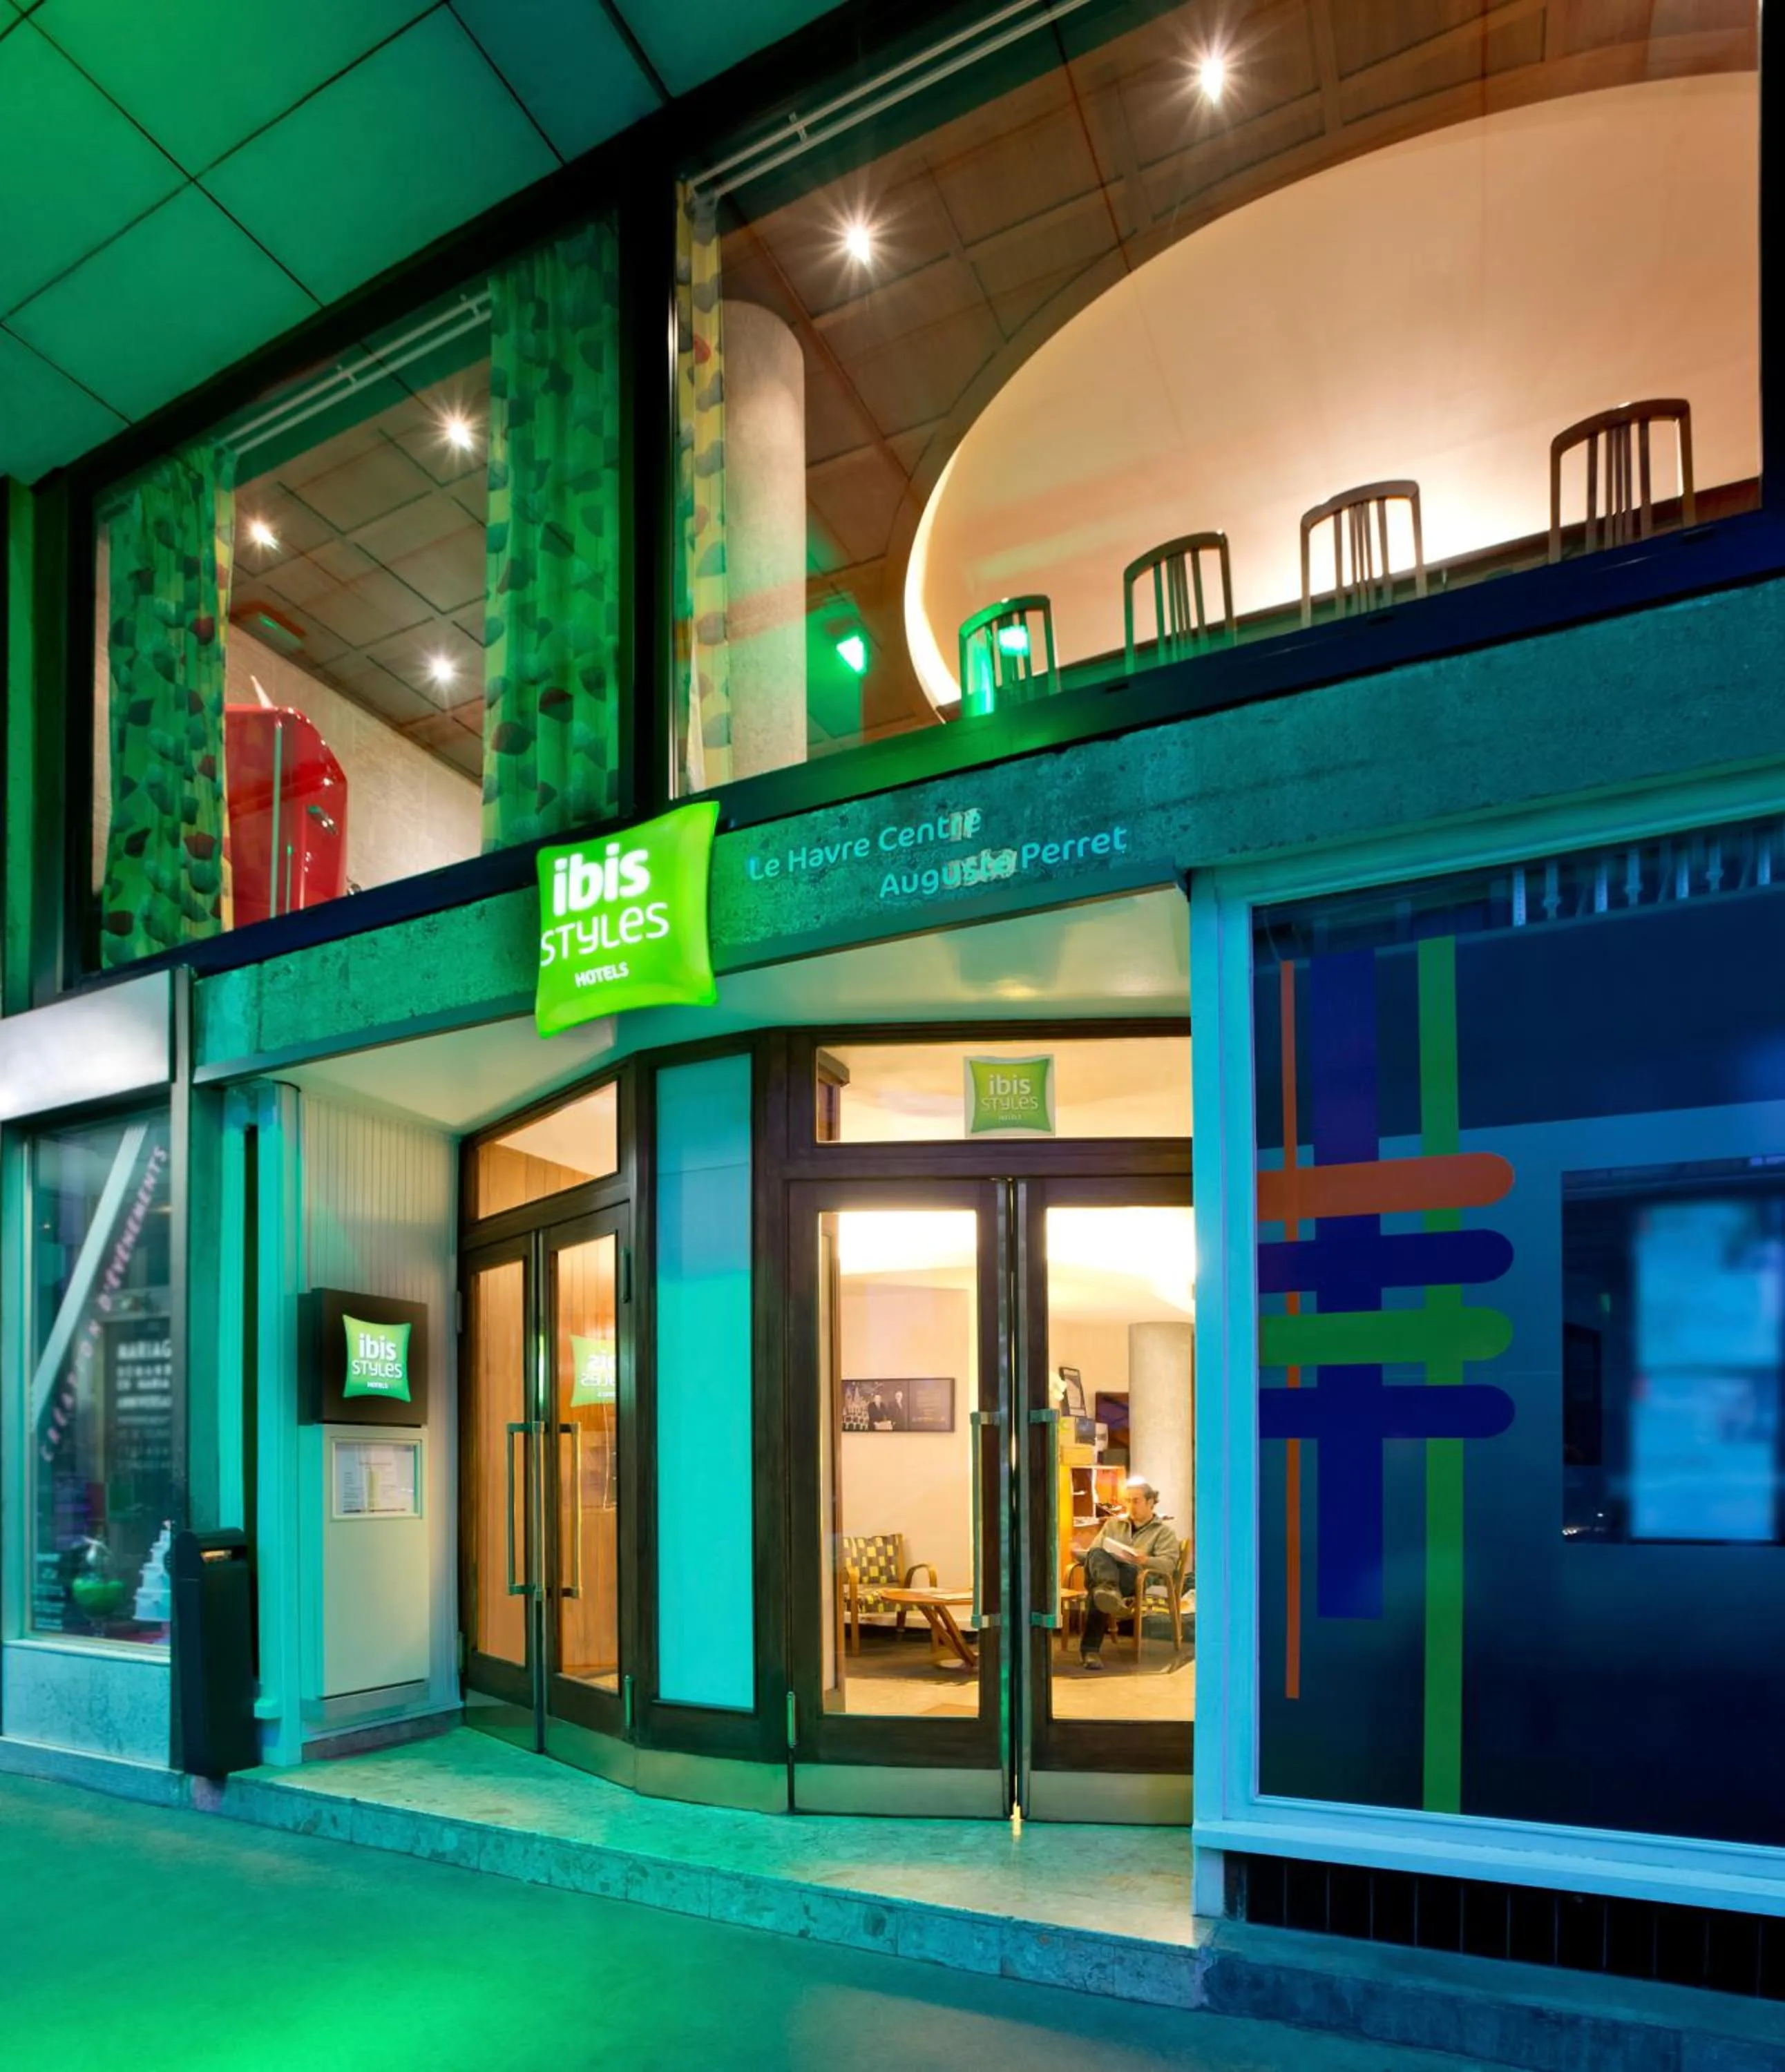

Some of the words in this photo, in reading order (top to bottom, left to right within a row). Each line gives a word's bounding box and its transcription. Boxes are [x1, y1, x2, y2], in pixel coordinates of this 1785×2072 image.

[747, 856, 780, 881] Le
[788, 837, 870, 872] Havre
[878, 809, 982, 852] Centre
[1022, 827, 1127, 869] Perret
[553, 843, 650, 917] ibis
[575, 961, 630, 988] HOTELS
[989, 1075, 1031, 1095] ibis
[359, 1332, 397, 1361] ibis
